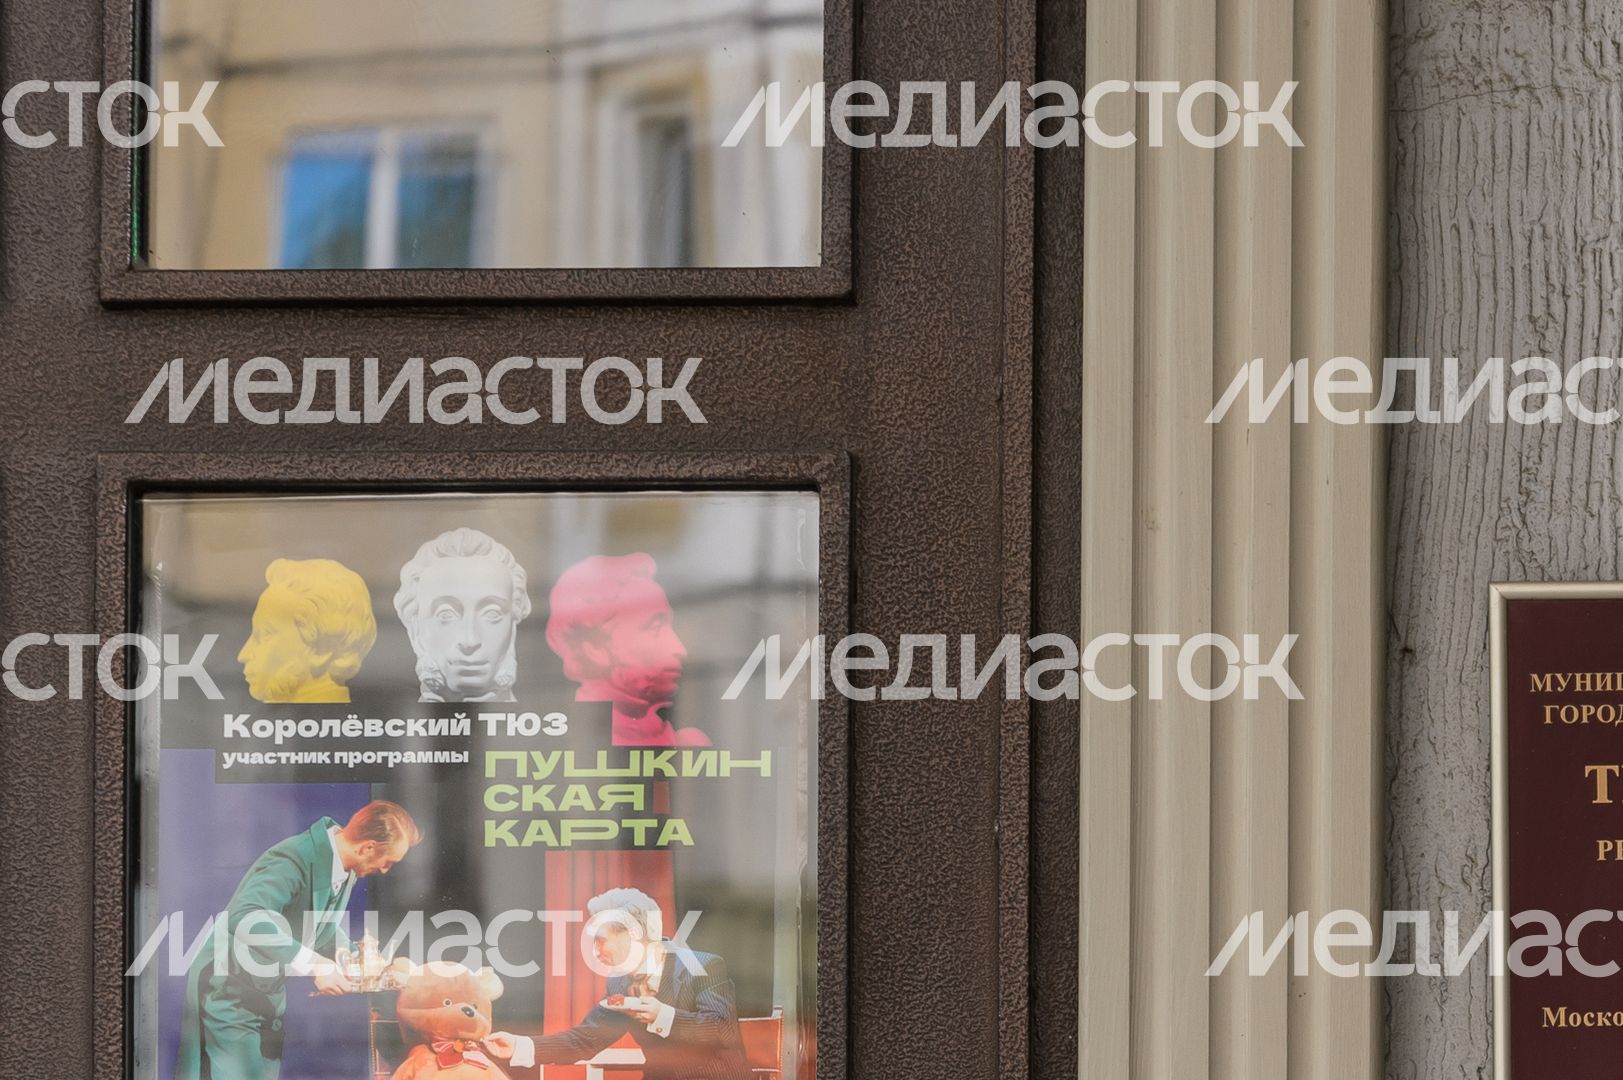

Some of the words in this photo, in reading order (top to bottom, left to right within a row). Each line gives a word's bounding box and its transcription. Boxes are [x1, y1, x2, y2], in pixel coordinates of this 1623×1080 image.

[223, 712, 471, 744] Королёвский
[478, 712, 569, 737] ТЮЗ
[222, 751, 332, 769] участник
[334, 750, 469, 768] программы
[484, 750, 772, 781] ПУШКИН
[483, 784, 645, 811] СКАЯ
[484, 819, 695, 847] КАРТА
